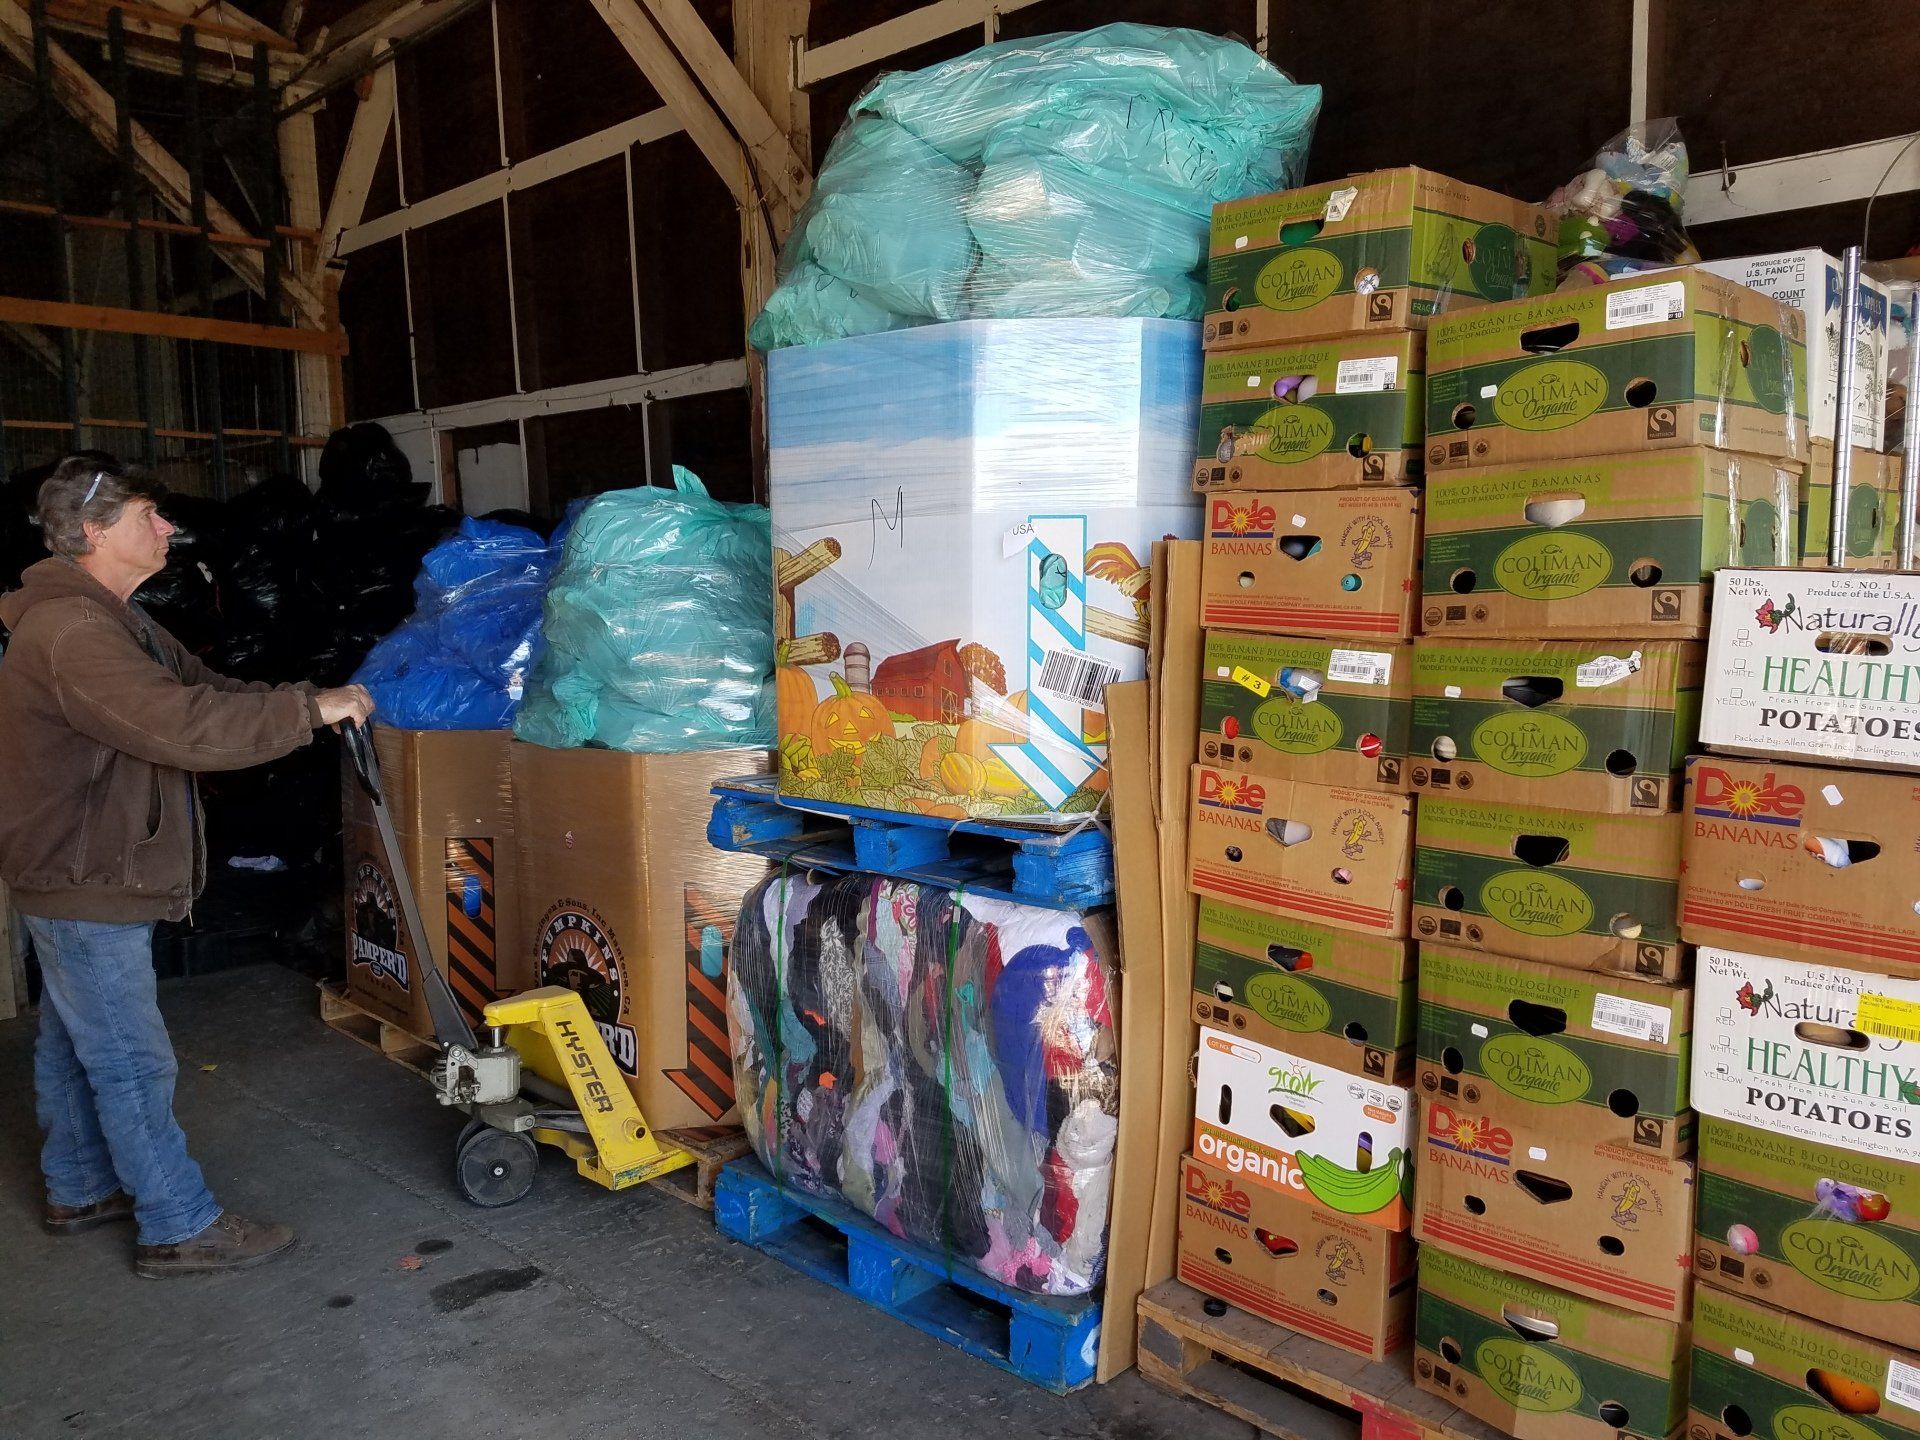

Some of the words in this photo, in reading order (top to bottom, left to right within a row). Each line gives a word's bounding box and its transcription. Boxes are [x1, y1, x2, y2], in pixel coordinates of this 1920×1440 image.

[1747, 268, 1763, 277] U.S.
[1766, 265, 1794, 274] FANCY
[1752, 260, 1778, 268] PRODUCE
[1261, 265, 1336, 288] COLIMAN
[1746, 278, 1778, 288] UTILITY
[1276, 282, 1318, 301] Organic
[1772, 289, 1805, 300] COUNT
[1436, 326, 1457, 339] 100%
[1459, 313, 1522, 331] ORGANIC
[1528, 299, 1596, 320] BANANAS
[1226, 359, 1263, 371] BANANE
[1265, 353, 1330, 367] BIOLOGIQUE
[1501, 377, 1599, 407] COLIMAN
[1522, 397, 1578, 420] Organic
[1270, 422, 1329, 439] OLIMAN
[1269, 434, 1311, 455] Organic
[1435, 487, 1457, 499] 100%
[1461, 479, 1527, 495] ORGANIC
[1531, 473, 1601, 488] BANANAS
[1211, 499, 1276, 532] Dole
[1352, 516, 1365, 525] WITH
[1372, 516, 1384, 526] COOL
[1012, 524, 1035, 536] USA
[1211, 542, 1272, 556] BANANAS
[1502, 552, 1603, 574] COLIMAN
[1523, 568, 1580, 590] Organic
[1729, 578, 1741, 586] 50
[1743, 577, 1764, 587] lbs.
[1831, 580, 1854, 589] U.S.
[1859, 581, 1881, 589] NO.
[1728, 587, 1748, 596] Net
[1751, 587, 1771, 597] Wt.
[1806, 588, 1847, 598] Produce
[1852, 589, 1862, 598] of
[1865, 590, 1880, 598] the
[1883, 591, 1915, 600] U.S.A.
[1416, 654, 1437, 663] 100%
[1439, 655, 1487, 665] BANANE
[1491, 656, 1575, 668] BIOLOGIQUE
[1240, 674, 1250, 683] #
[1253, 680, 1261, 690] 3
[1724, 669, 1755, 678] WHITE
[1715, 697, 1756, 707] YELLOW
[1258, 711, 1336, 733] COLIMAN
[1274, 726, 1319, 747] Organic
[1479, 730, 1579, 752] COLIMAN
[1501, 745, 1557, 768] Organic
[1199, 769, 1266, 808] Dole
[1696, 767, 1805, 816] Dole
[1199, 810, 1261, 832] BANANAS
[1424, 804, 1446, 815] 100%
[1449, 807, 1513, 827] ORGANIC
[1518, 818, 1585, 832] BANANAS
[1694, 821, 1798, 850] BANANAS
[1488, 887, 1586, 915] COLIMAN
[1509, 901, 1563, 927] Organic
[1219, 911, 1256, 928] BANANE
[1258, 919, 1323, 947] BIOLOGIQUE
[352, 931, 408, 985] PAMPER'D
[541, 915, 618, 981] PUMPKINS
[1709, 956, 1721, 965] 50
[1723, 958, 1742, 969] lbs.
[1709, 966, 1729, 976] Net
[1731, 970, 1750, 980] Wt.
[1423, 960, 1444, 971] 100%
[1446, 963, 1494, 981] BANANE
[1496, 975, 1581, 1000] BIOLOGIQUE
[1807, 971, 1829, 982] U.S.
[1833, 975, 1855, 986] NO.
[1859, 979, 1864, 987] 1
[1251, 983, 1325, 1016] COLIMAN
[1266, 1001, 1308, 1023] Organic
[1715, 1017, 1735, 1027] RED
[1208, 1038, 1219, 1048] LOT
[1710, 1044, 1739, 1056] WHITE
[556, 1020, 613, 1114] HYSTER
[1487, 1047, 1582, 1083] COLIMAN
[1747, 1036, 1916, 1103] HEALTHY
[1268, 1065, 1324, 1096] grow
[1507, 1068, 1561, 1094] Organic
[1703, 1071, 1743, 1084] YELLOW
[1753, 1076, 1783, 1088] Fresh
[1788, 1083, 1813, 1095] from
[1818, 1089, 1836, 1100] the
[1842, 1094, 1863, 1105] Sun
[1883, 1103, 1907, 1113] Soil
[1746, 1086, 1913, 1139] POTATOES
[1428, 1103, 1513, 1155] Dole
[1723, 1108, 1752, 1122] Packed
[1755, 1115, 1768, 1125] By:
[1770, 1119, 1792, 1130] Allen
[1794, 1125, 1817, 1137] Grain
[1819, 1131, 1838, 1142] Inc.,
[1841, 1135, 1892, 1151] Burlington,
[1895, 1145, 1910, 1155] WA
[1199, 1133, 1306, 1190] organic
[1429, 1148, 1509, 1184] BANANAS
[1594, 1145, 1625, 1155] PRODUCT
[1637, 1153, 1668, 1165] ECUADOR
[1706, 1124, 1732, 1140] 100%
[1737, 1132, 1795, 1157] BANANE
[1801, 1147, 1906, 1186] BIOLOGIQUE
[1710, 1136, 1748, 1153] PRODUCT
[1750, 1148, 1761, 1157] OF
[1763, 1151, 1796, 1167] MEXICO
[1803, 1162, 1837, 1177] PRODUIT
[1839, 1171, 1850, 1179] DU
[1186, 1164, 1250, 1215] Dole
[1186, 1204, 1248, 1240] BANANAS
[1789, 1232, 1910, 1282] COLIMAN
[1814, 1255, 1883, 1288] Organic
[1444, 1255, 1490, 1282] BANANE
[1493, 1275, 1574, 1312] BIOLOGIQUE
[1700, 1302, 1725, 1319] 100%
[1729, 1313, 1786, 1340] BANANE
[1791, 1337, 1885, 1377] BIOLOGIQU
[1482, 1348, 1575, 1394] COLIMAN
[1499, 1372, 1553, 1401] Organic
